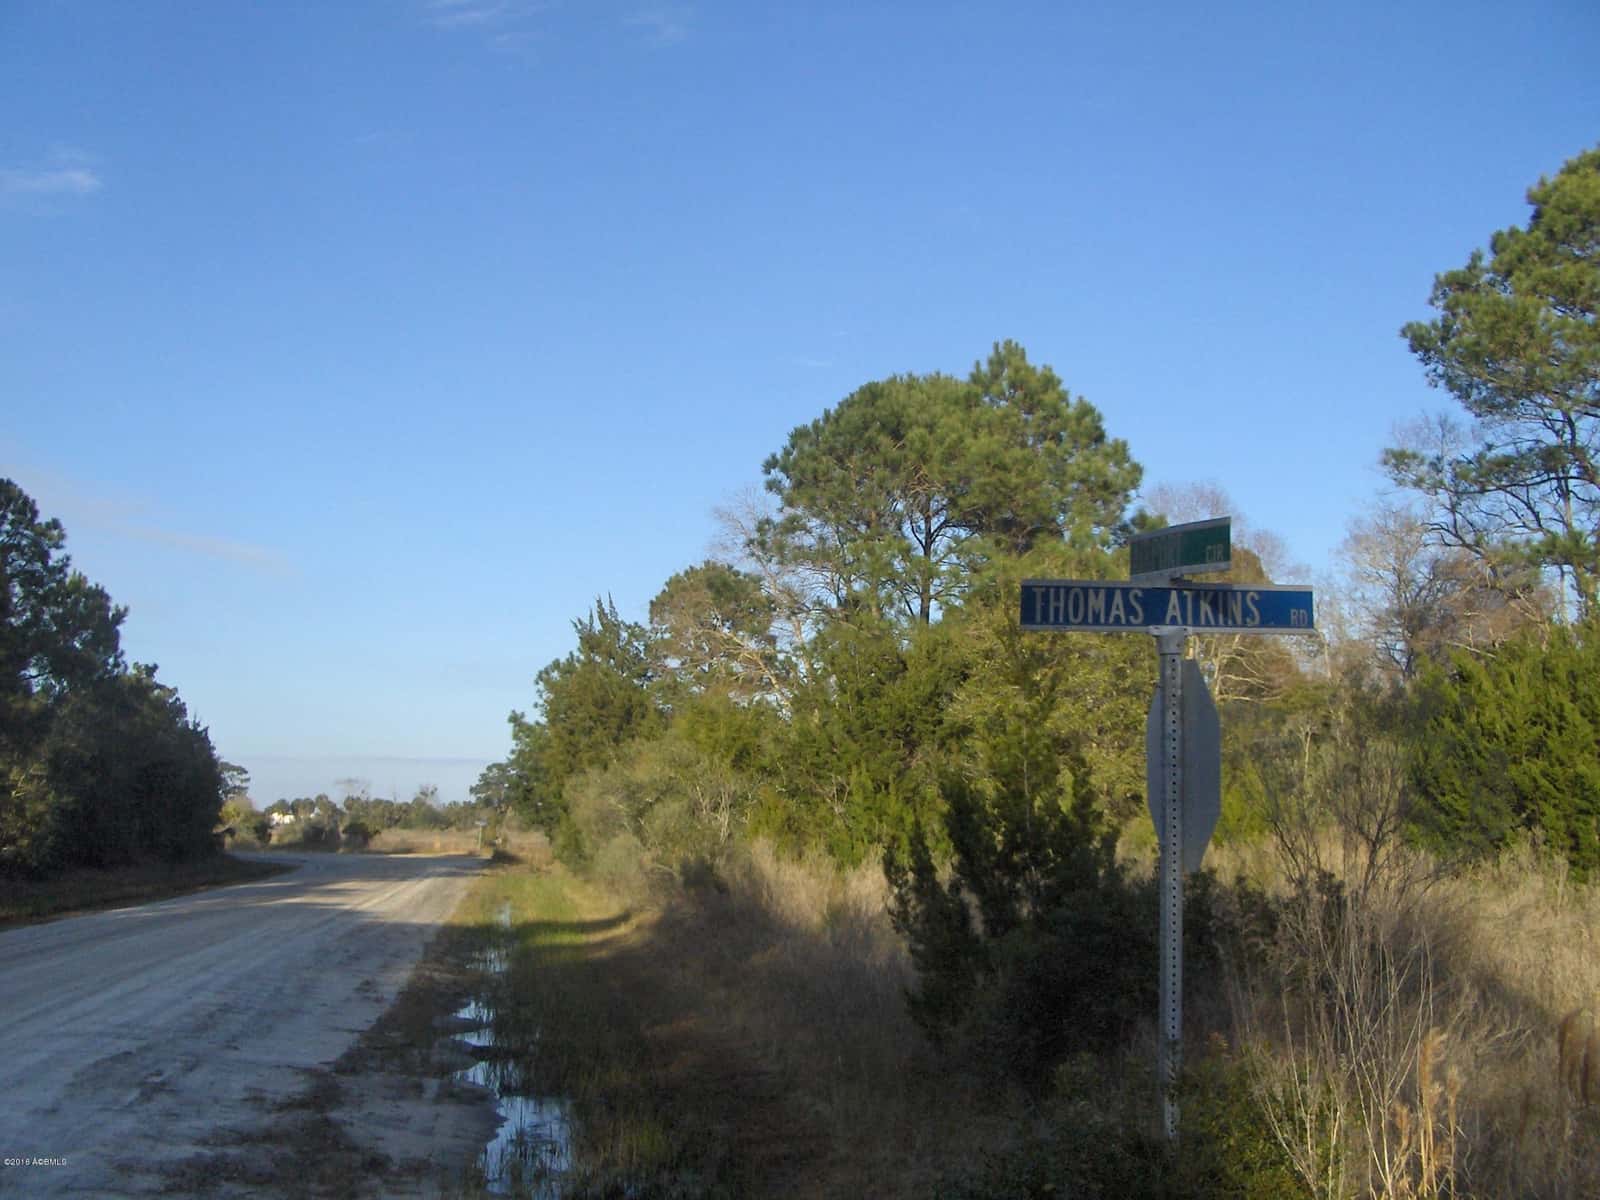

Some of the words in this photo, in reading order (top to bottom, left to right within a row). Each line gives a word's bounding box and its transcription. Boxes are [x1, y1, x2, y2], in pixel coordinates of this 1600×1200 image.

[1032, 587, 1145, 626] THOMAS
[1165, 589, 1261, 626] ATKINS
[1290, 608, 1308, 626] RD
